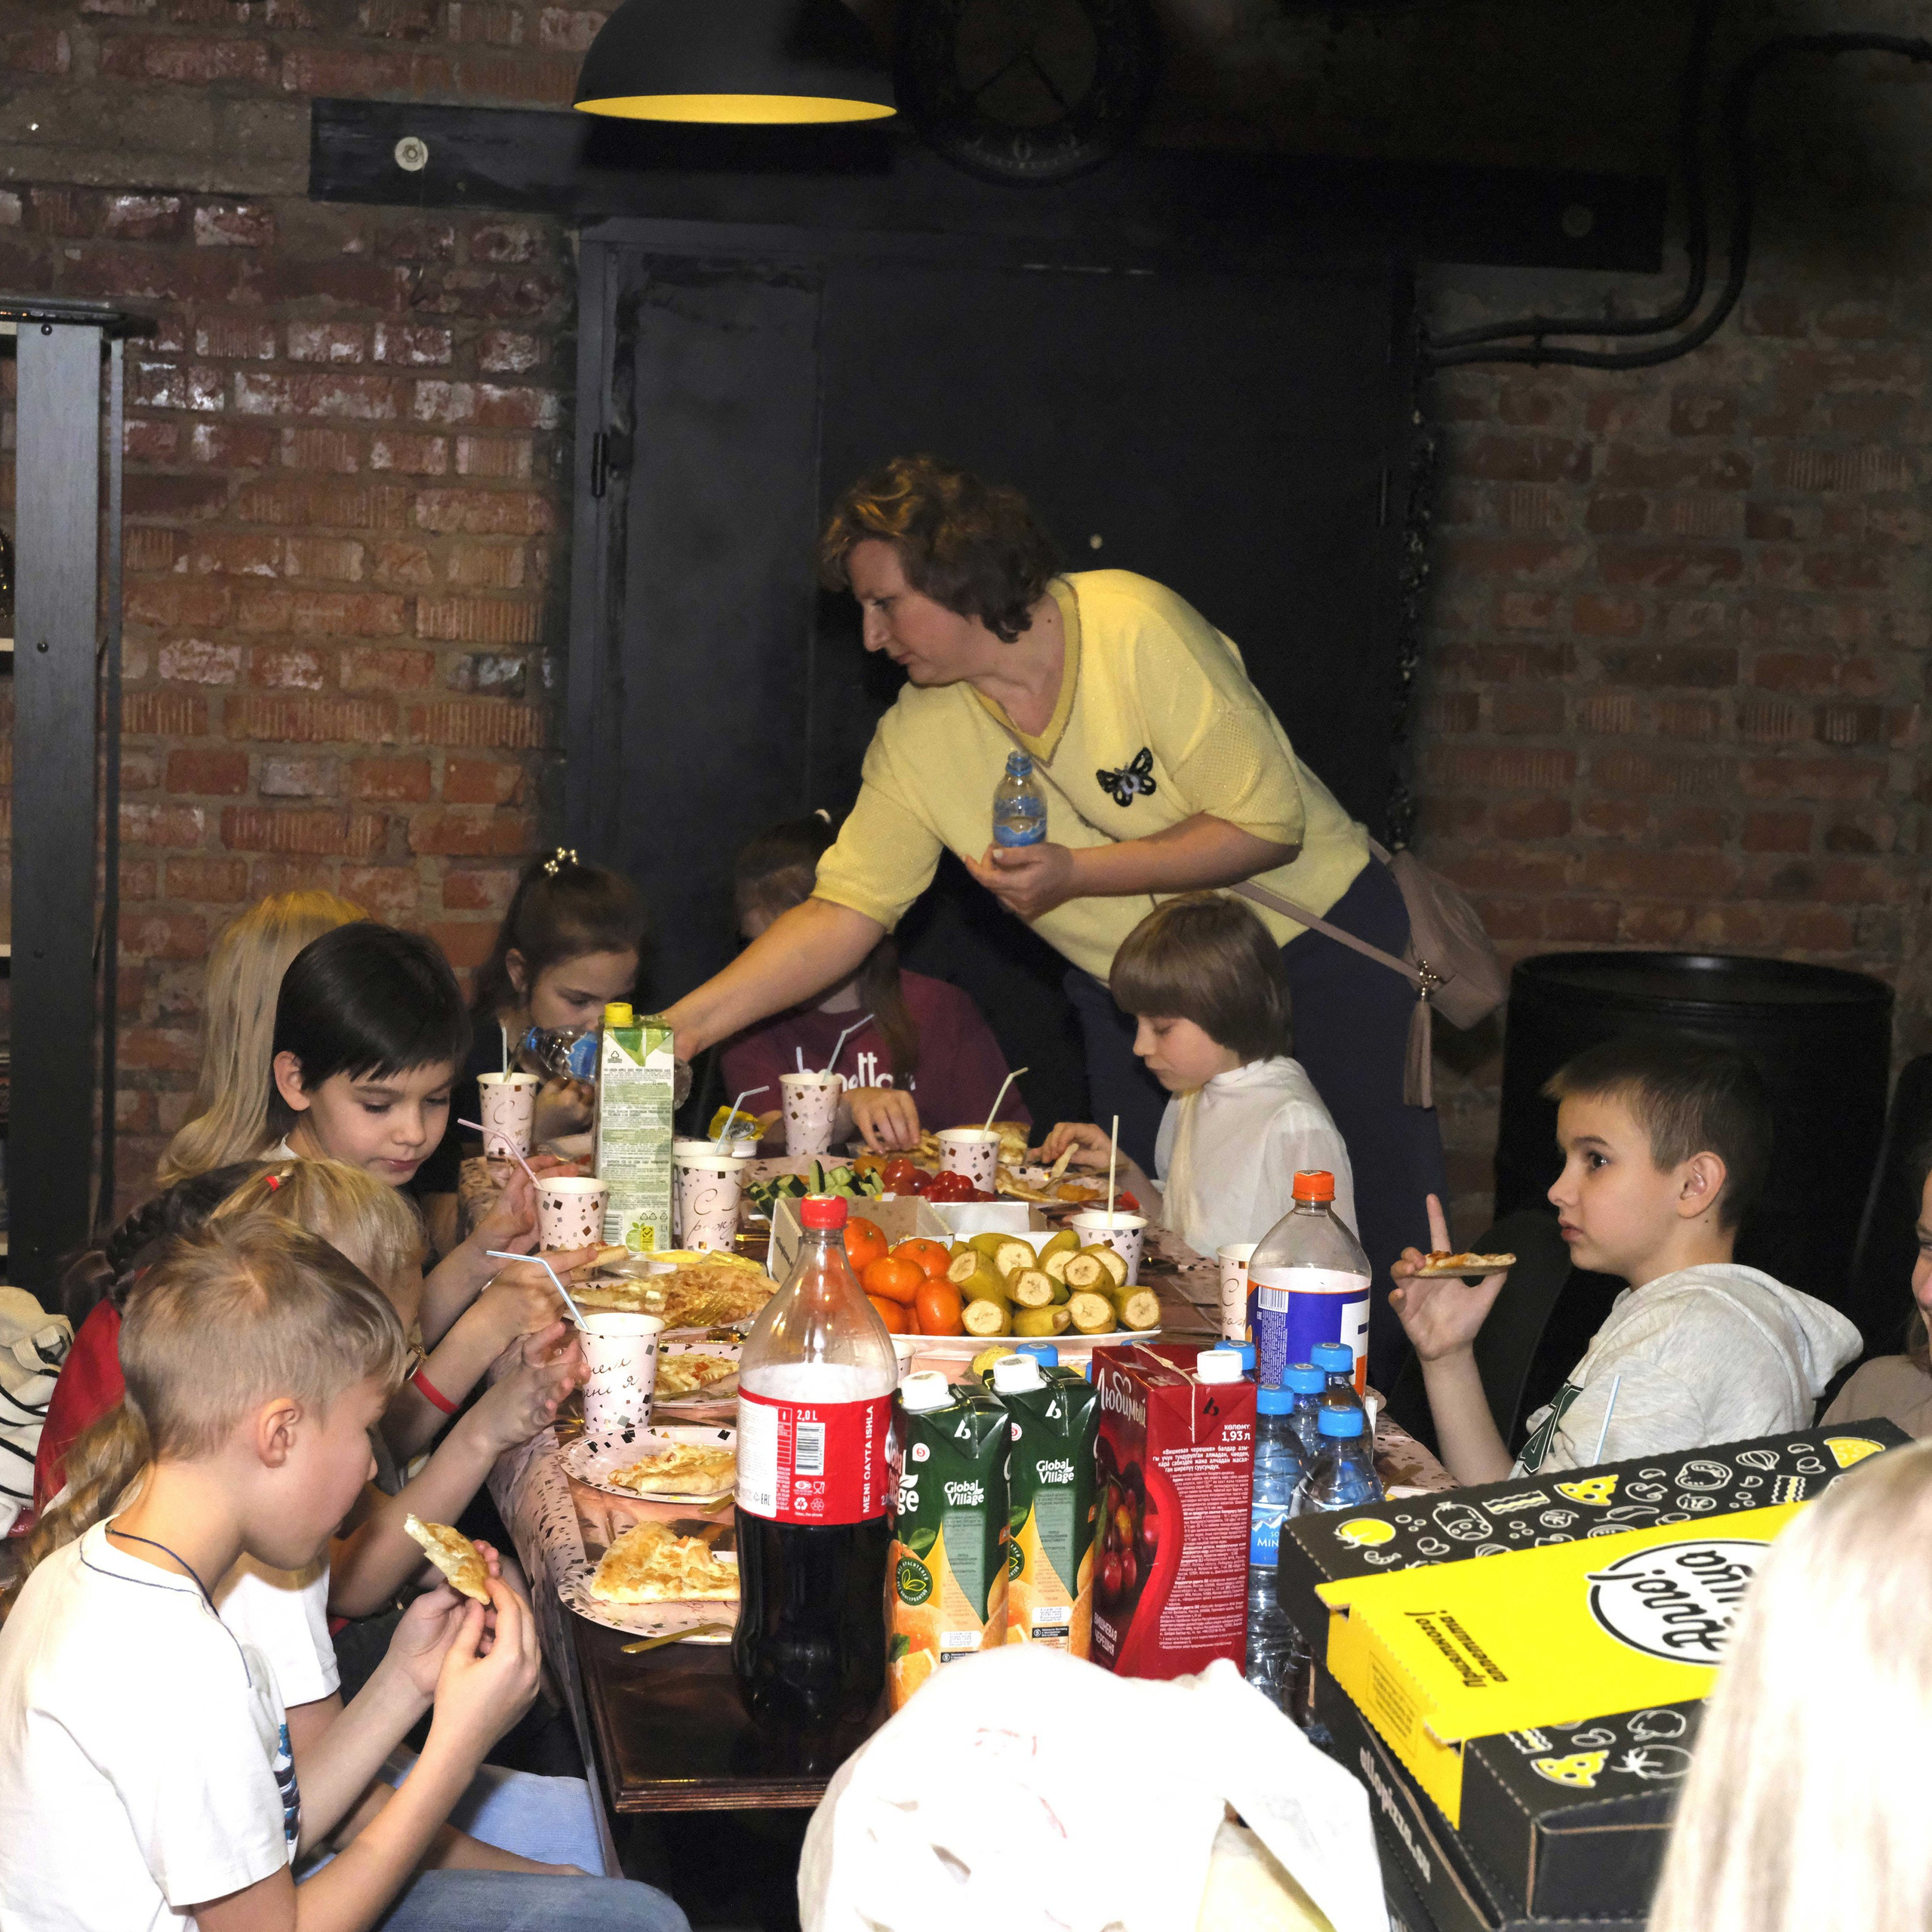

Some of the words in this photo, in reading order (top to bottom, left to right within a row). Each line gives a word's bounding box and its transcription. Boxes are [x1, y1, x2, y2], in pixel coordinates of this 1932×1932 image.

[1097, 1367, 1146, 1429] Любимый
[797, 1409, 811, 1421] 2,0
[812, 1410, 818, 1420] L
[866, 1405, 874, 1439] ISHLA
[1222, 1431, 1243, 1441] 1,93
[1036, 1458, 1071, 1473] Global
[1038, 1470, 1075, 1484] Village
[944, 1480, 981, 1494] Global
[863, 1482, 871, 1513] MENI
[947, 1492, 985, 1506] Village
[1257, 1537, 1280, 1547] MIN
[1094, 1611, 1118, 1642] ВИШНЕВАЯ
[1094, 1628, 1115, 1657] ЧЕРЕШНЯ
